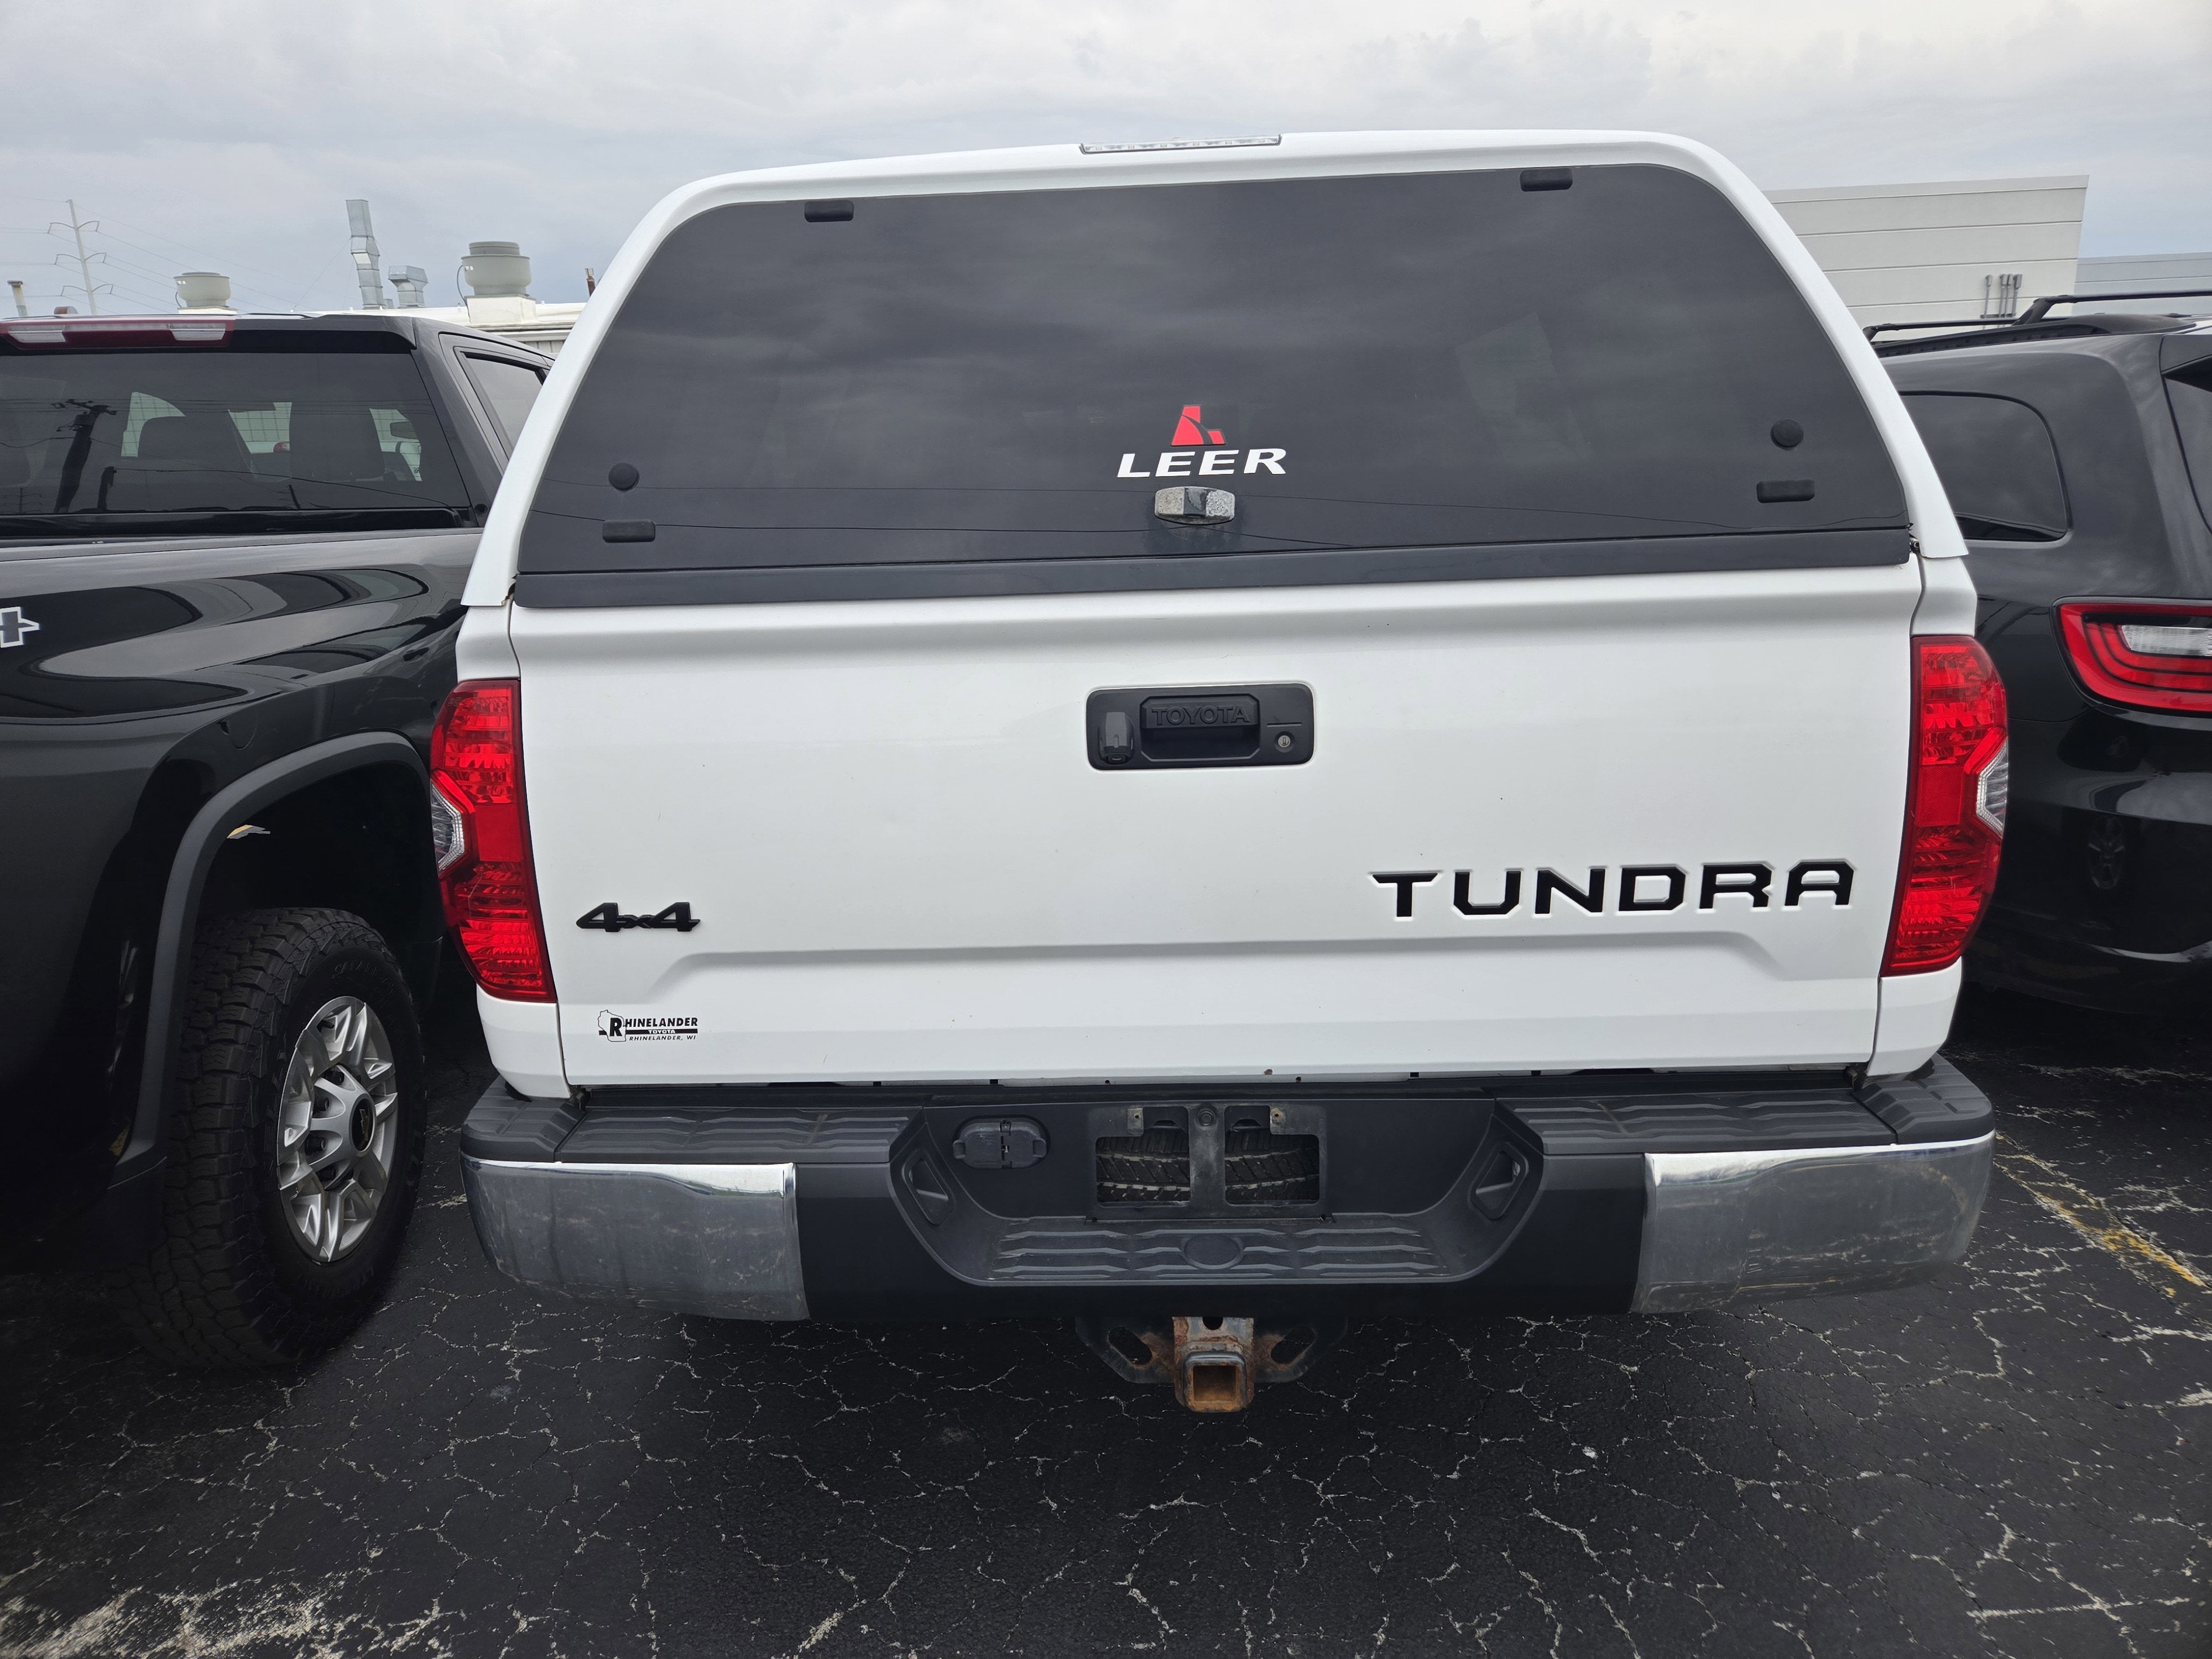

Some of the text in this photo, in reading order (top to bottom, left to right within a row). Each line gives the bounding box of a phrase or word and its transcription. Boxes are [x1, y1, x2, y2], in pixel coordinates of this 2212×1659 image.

[1117, 448, 1286, 478] LEER
[1151, 705, 1250, 726] TOYOTA
[1370, 860, 1855, 919] TUNDRA
[609, 1017, 698, 1037] RHINELANDER
